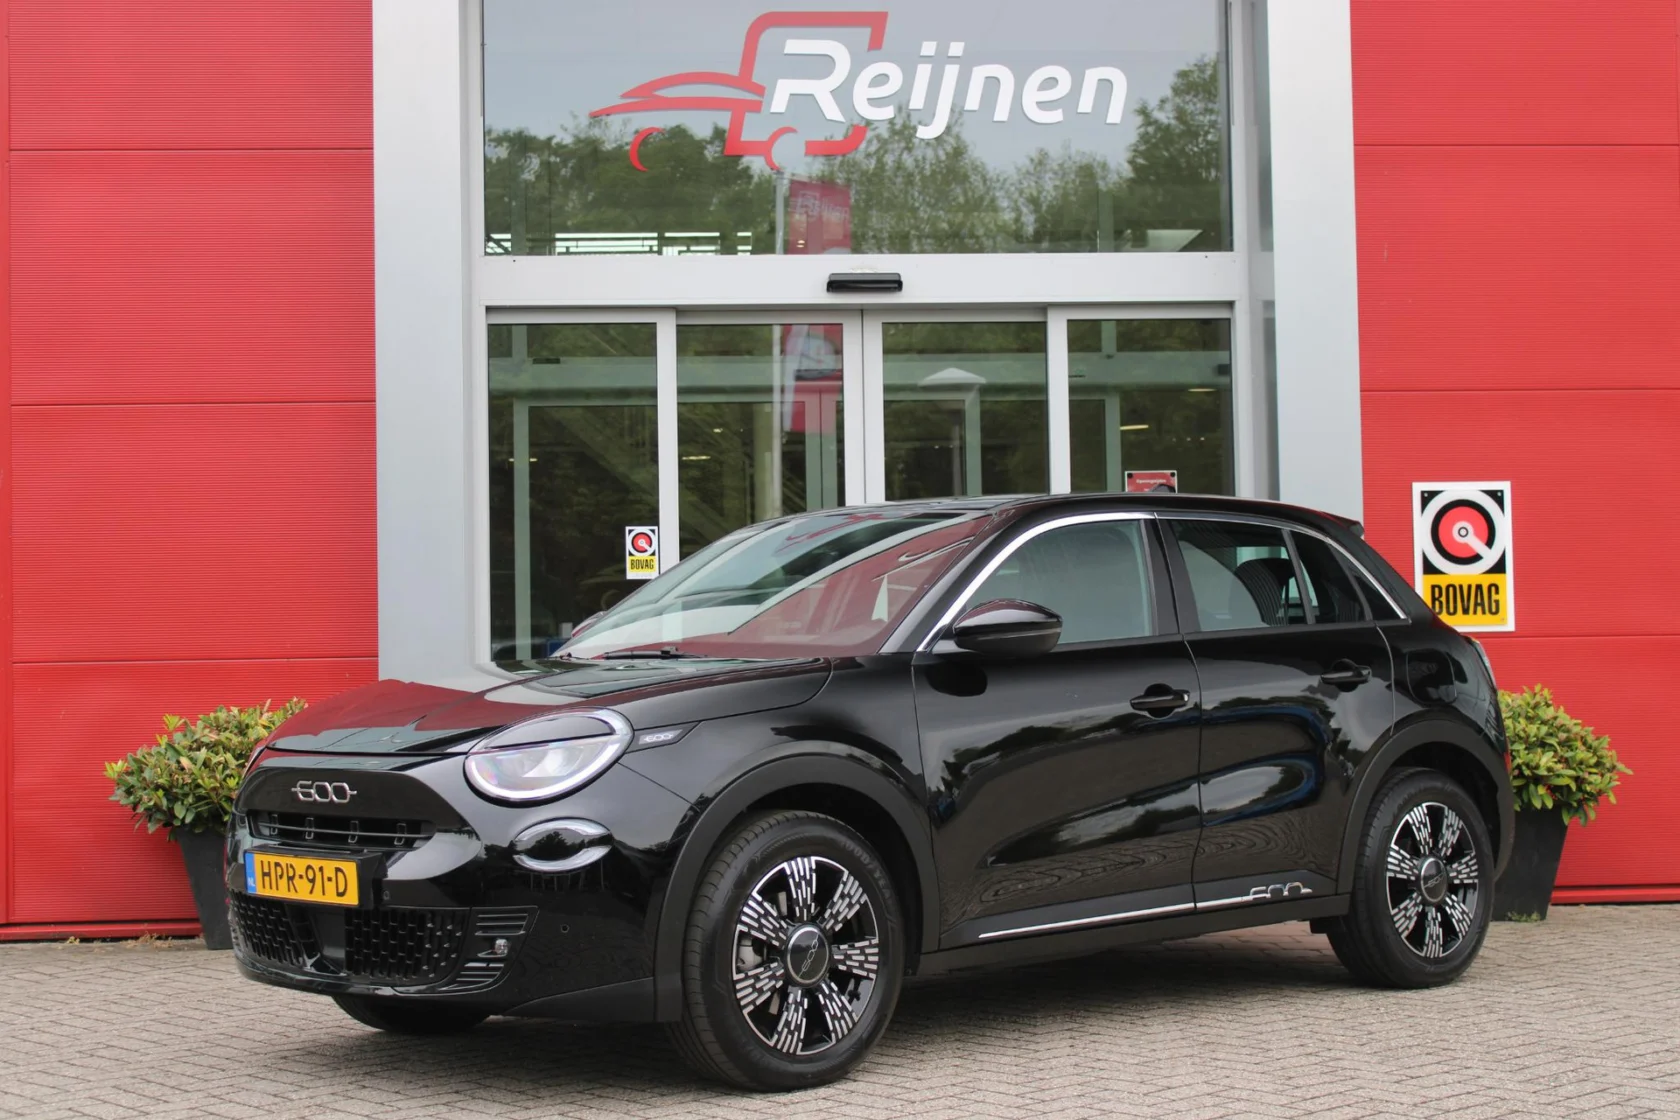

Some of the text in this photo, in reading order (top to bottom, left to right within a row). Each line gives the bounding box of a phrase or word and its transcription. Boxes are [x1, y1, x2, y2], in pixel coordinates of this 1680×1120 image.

[769, 39, 1128, 140] Reijnen
[630, 558, 655, 570] BOVAG
[1430, 583, 1500, 616] BOVAG
[292, 780, 357, 803] 600
[260, 859, 348, 898] HPR-91-D
